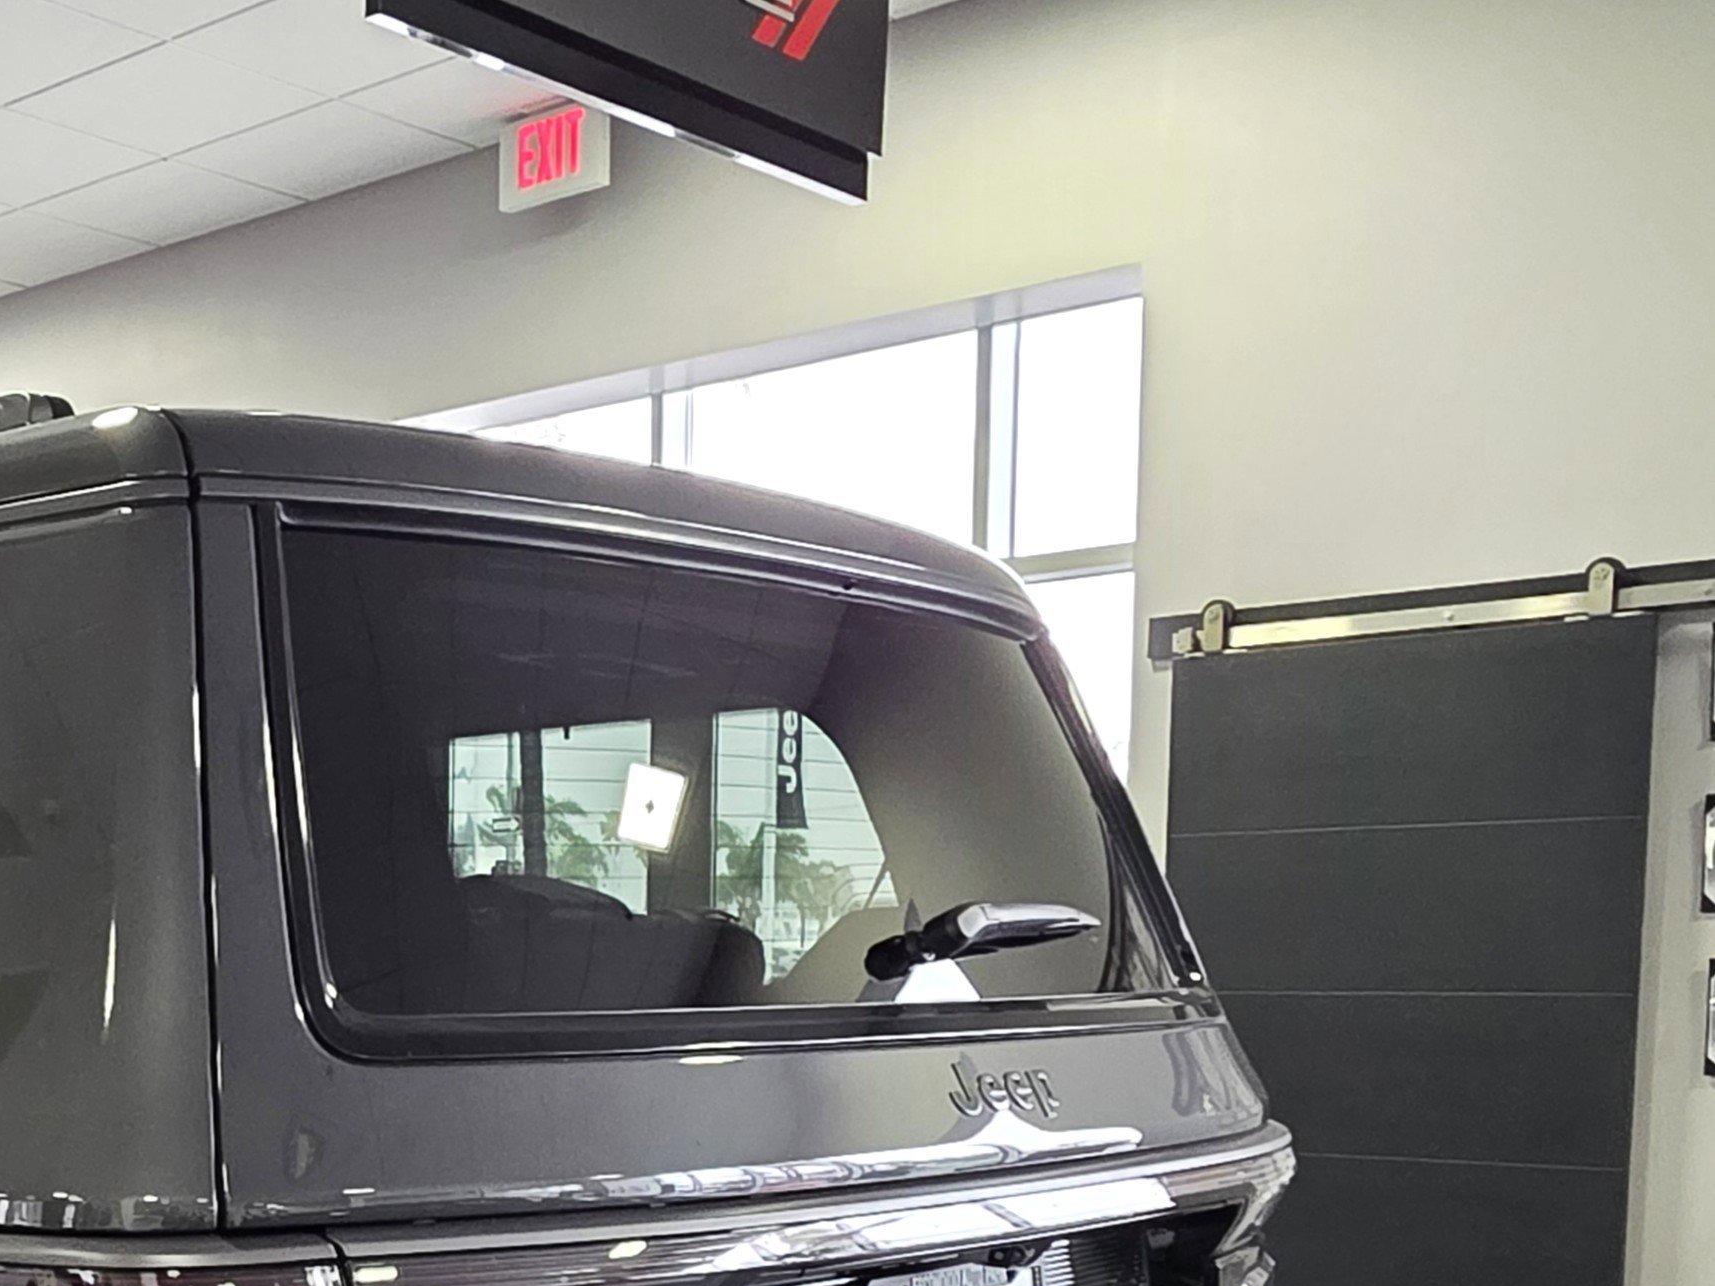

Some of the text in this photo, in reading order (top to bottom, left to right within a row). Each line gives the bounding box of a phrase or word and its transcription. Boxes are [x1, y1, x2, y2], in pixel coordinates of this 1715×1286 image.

[518, 108, 584, 190] EXIT
[777, 709, 799, 794] Jee
[948, 1052, 1061, 1119] Jeep
